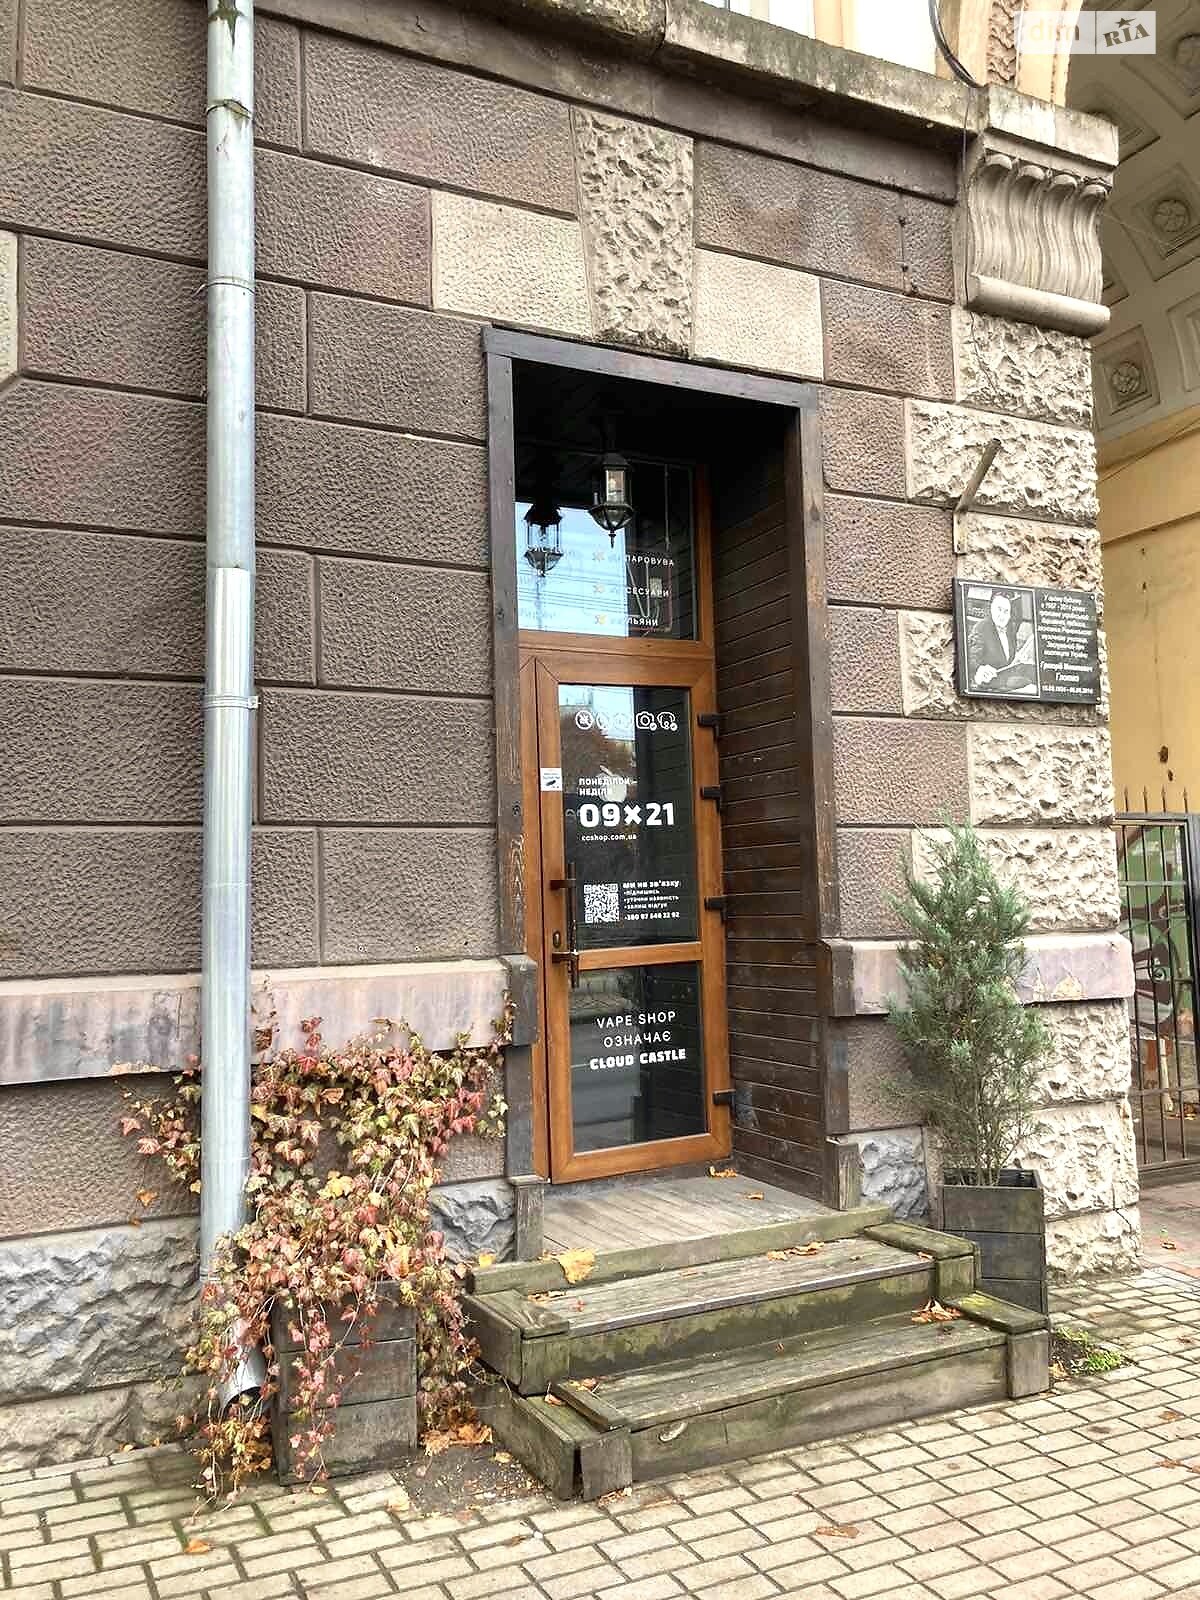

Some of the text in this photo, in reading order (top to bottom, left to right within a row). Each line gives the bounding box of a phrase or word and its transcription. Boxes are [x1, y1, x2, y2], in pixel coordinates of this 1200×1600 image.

[581, 833, 638, 843] ccshop.com.ua
[596, 1010, 676, 1029] VAPE SHOP
[603, 1030, 671, 1048] ОЗНАЧАЄ
[589, 1048, 687, 1070] CLOUD CASTLE
